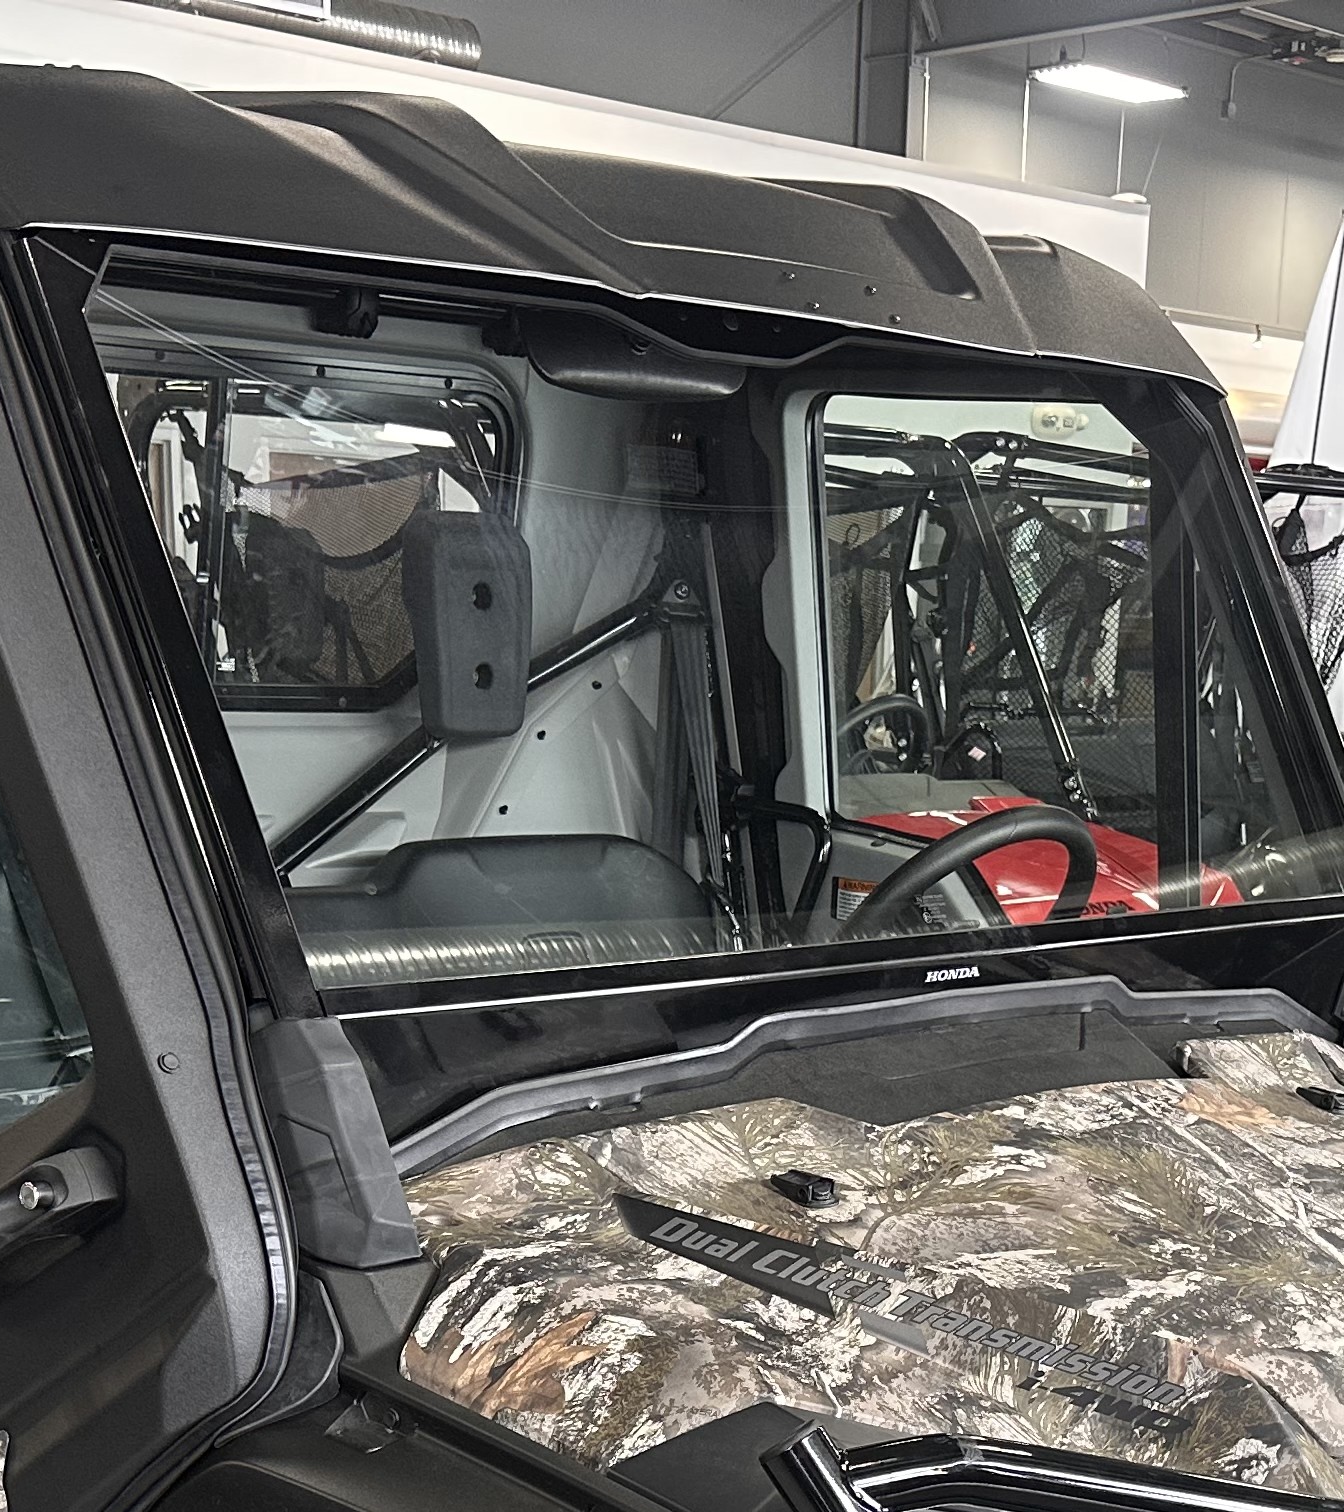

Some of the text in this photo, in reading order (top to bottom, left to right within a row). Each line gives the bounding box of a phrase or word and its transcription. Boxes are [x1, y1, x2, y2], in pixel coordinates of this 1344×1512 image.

[924, 965, 980, 983] HONDA
[650, 1216, 1186, 1405] Dual Clutch Transmission
